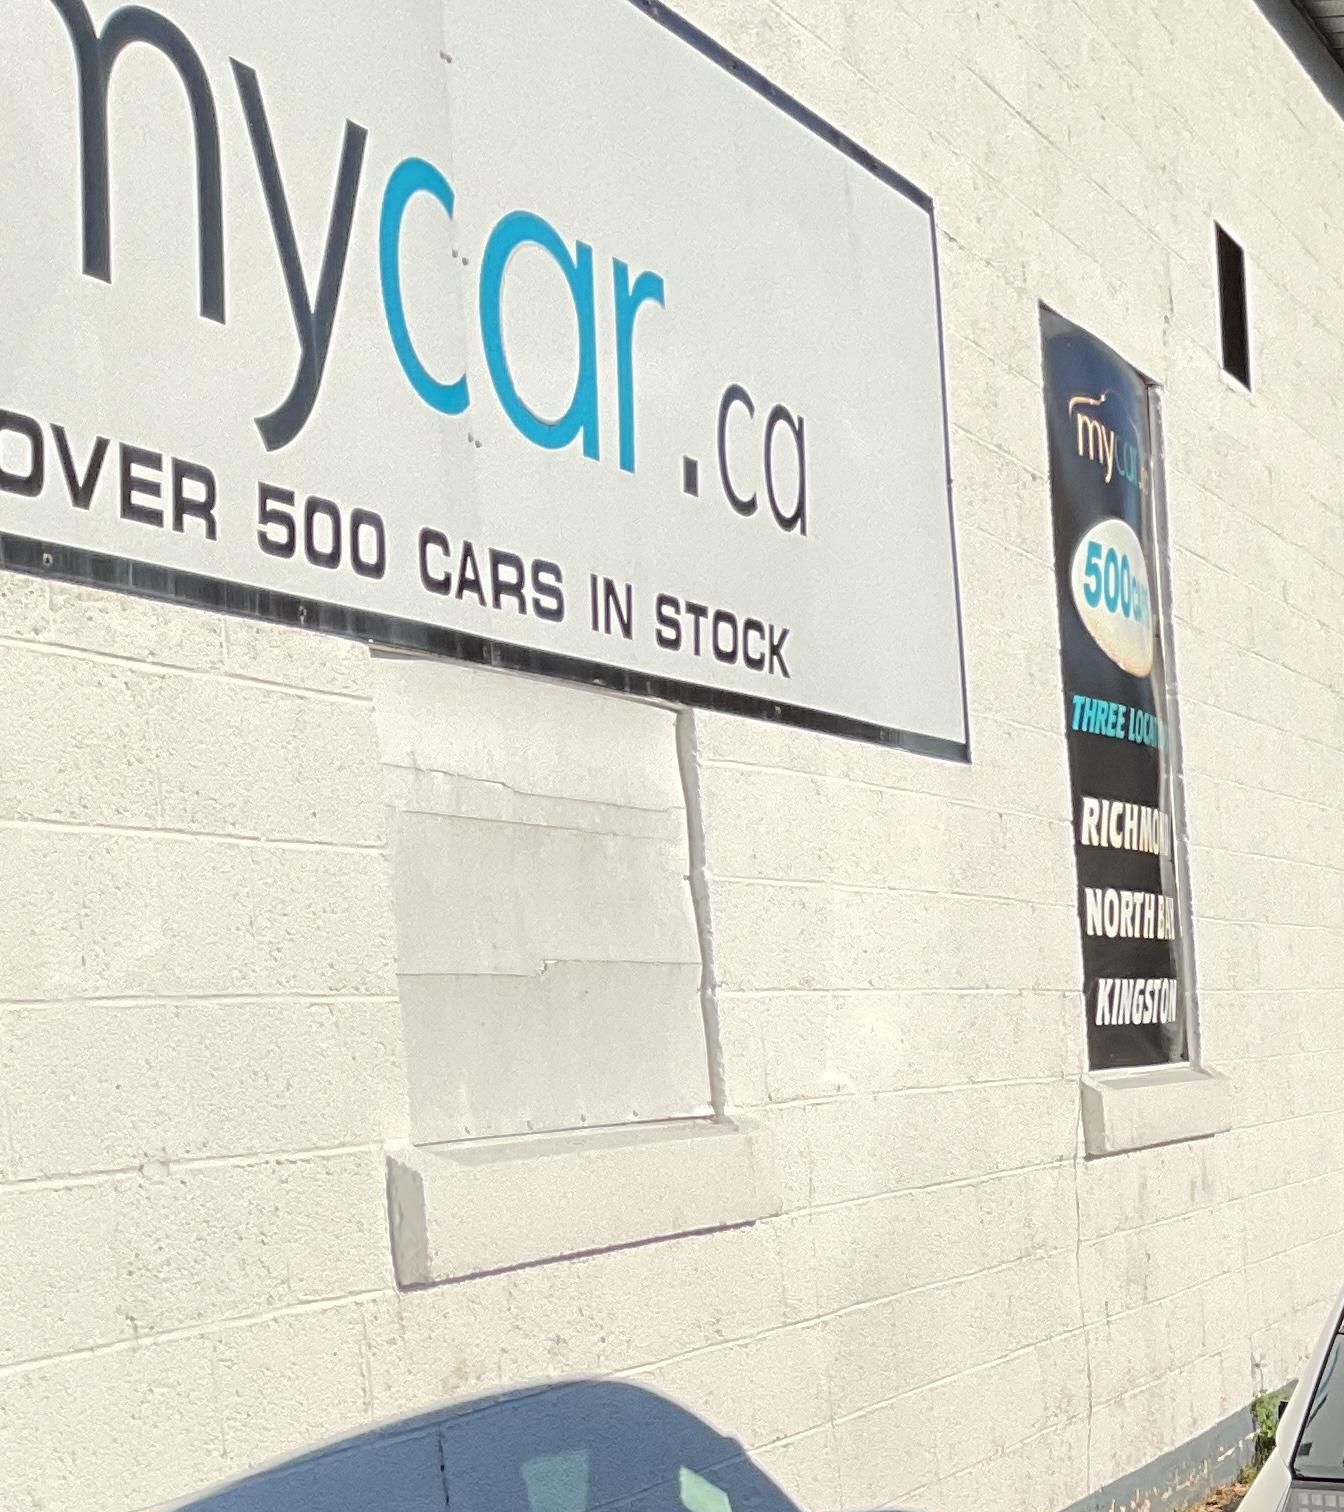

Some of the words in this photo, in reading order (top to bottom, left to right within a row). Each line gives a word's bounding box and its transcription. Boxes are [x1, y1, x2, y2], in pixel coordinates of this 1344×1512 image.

[0, 408, 218, 542] OVER
[256, 480, 387, 580] 500
[418, 526, 565, 623] CARS
[590, 573, 633, 641] IN
[655, 592, 791, 679] STOCK
[1072, 694, 1127, 739] THREE
[1084, 887, 1156, 939] NORTH
[1095, 977, 1178, 1026] KINGSTON
